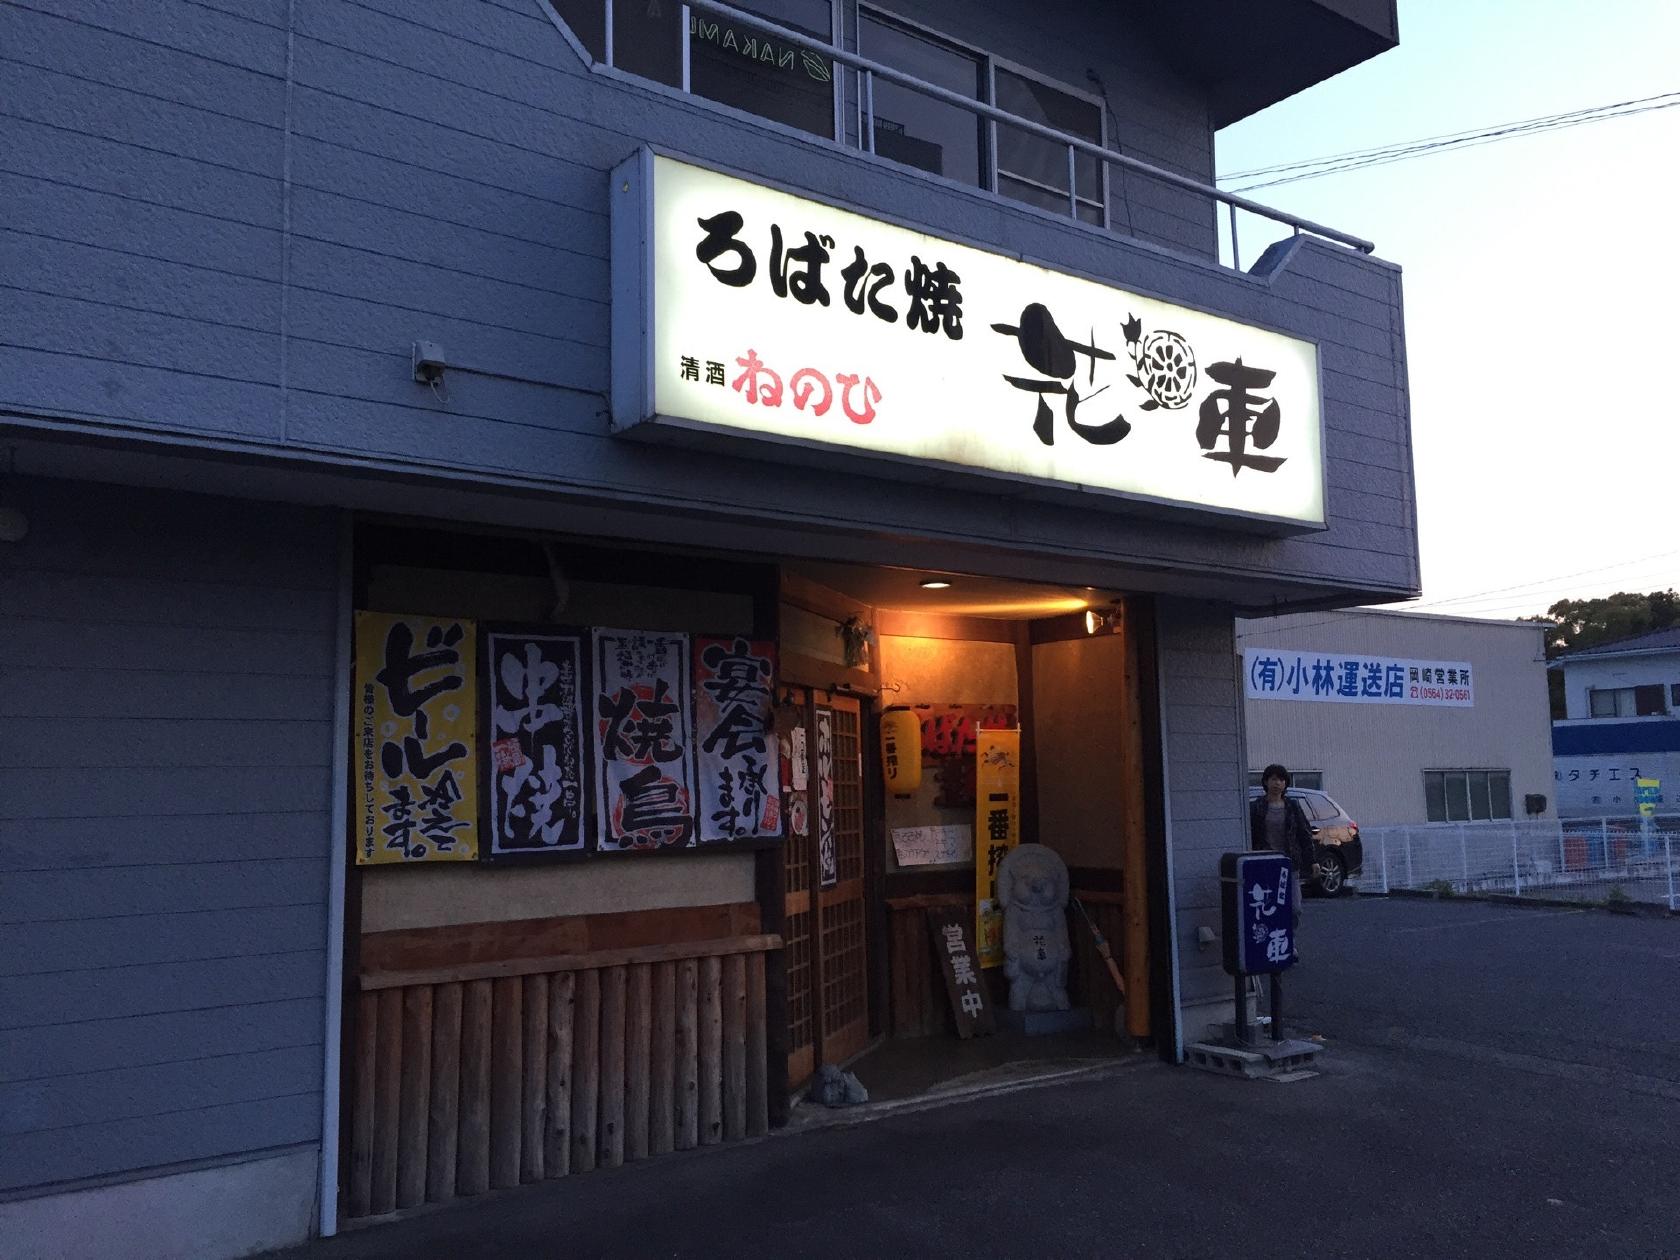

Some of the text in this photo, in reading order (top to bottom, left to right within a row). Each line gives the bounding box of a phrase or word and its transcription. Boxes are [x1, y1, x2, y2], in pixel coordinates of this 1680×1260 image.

[695, 209, 964, 340] ろばた焼
[679, 348, 882, 425] 清酒 ねのひ
[375, 622, 467, 779] ビール
[703, 639, 772, 760] 宴会
[1251, 656, 1471, 699] (有)小林運送店 岡崎営業所
[598, 678, 692, 849] 焼鳥
[942, 922, 983, 1018] 営業中
